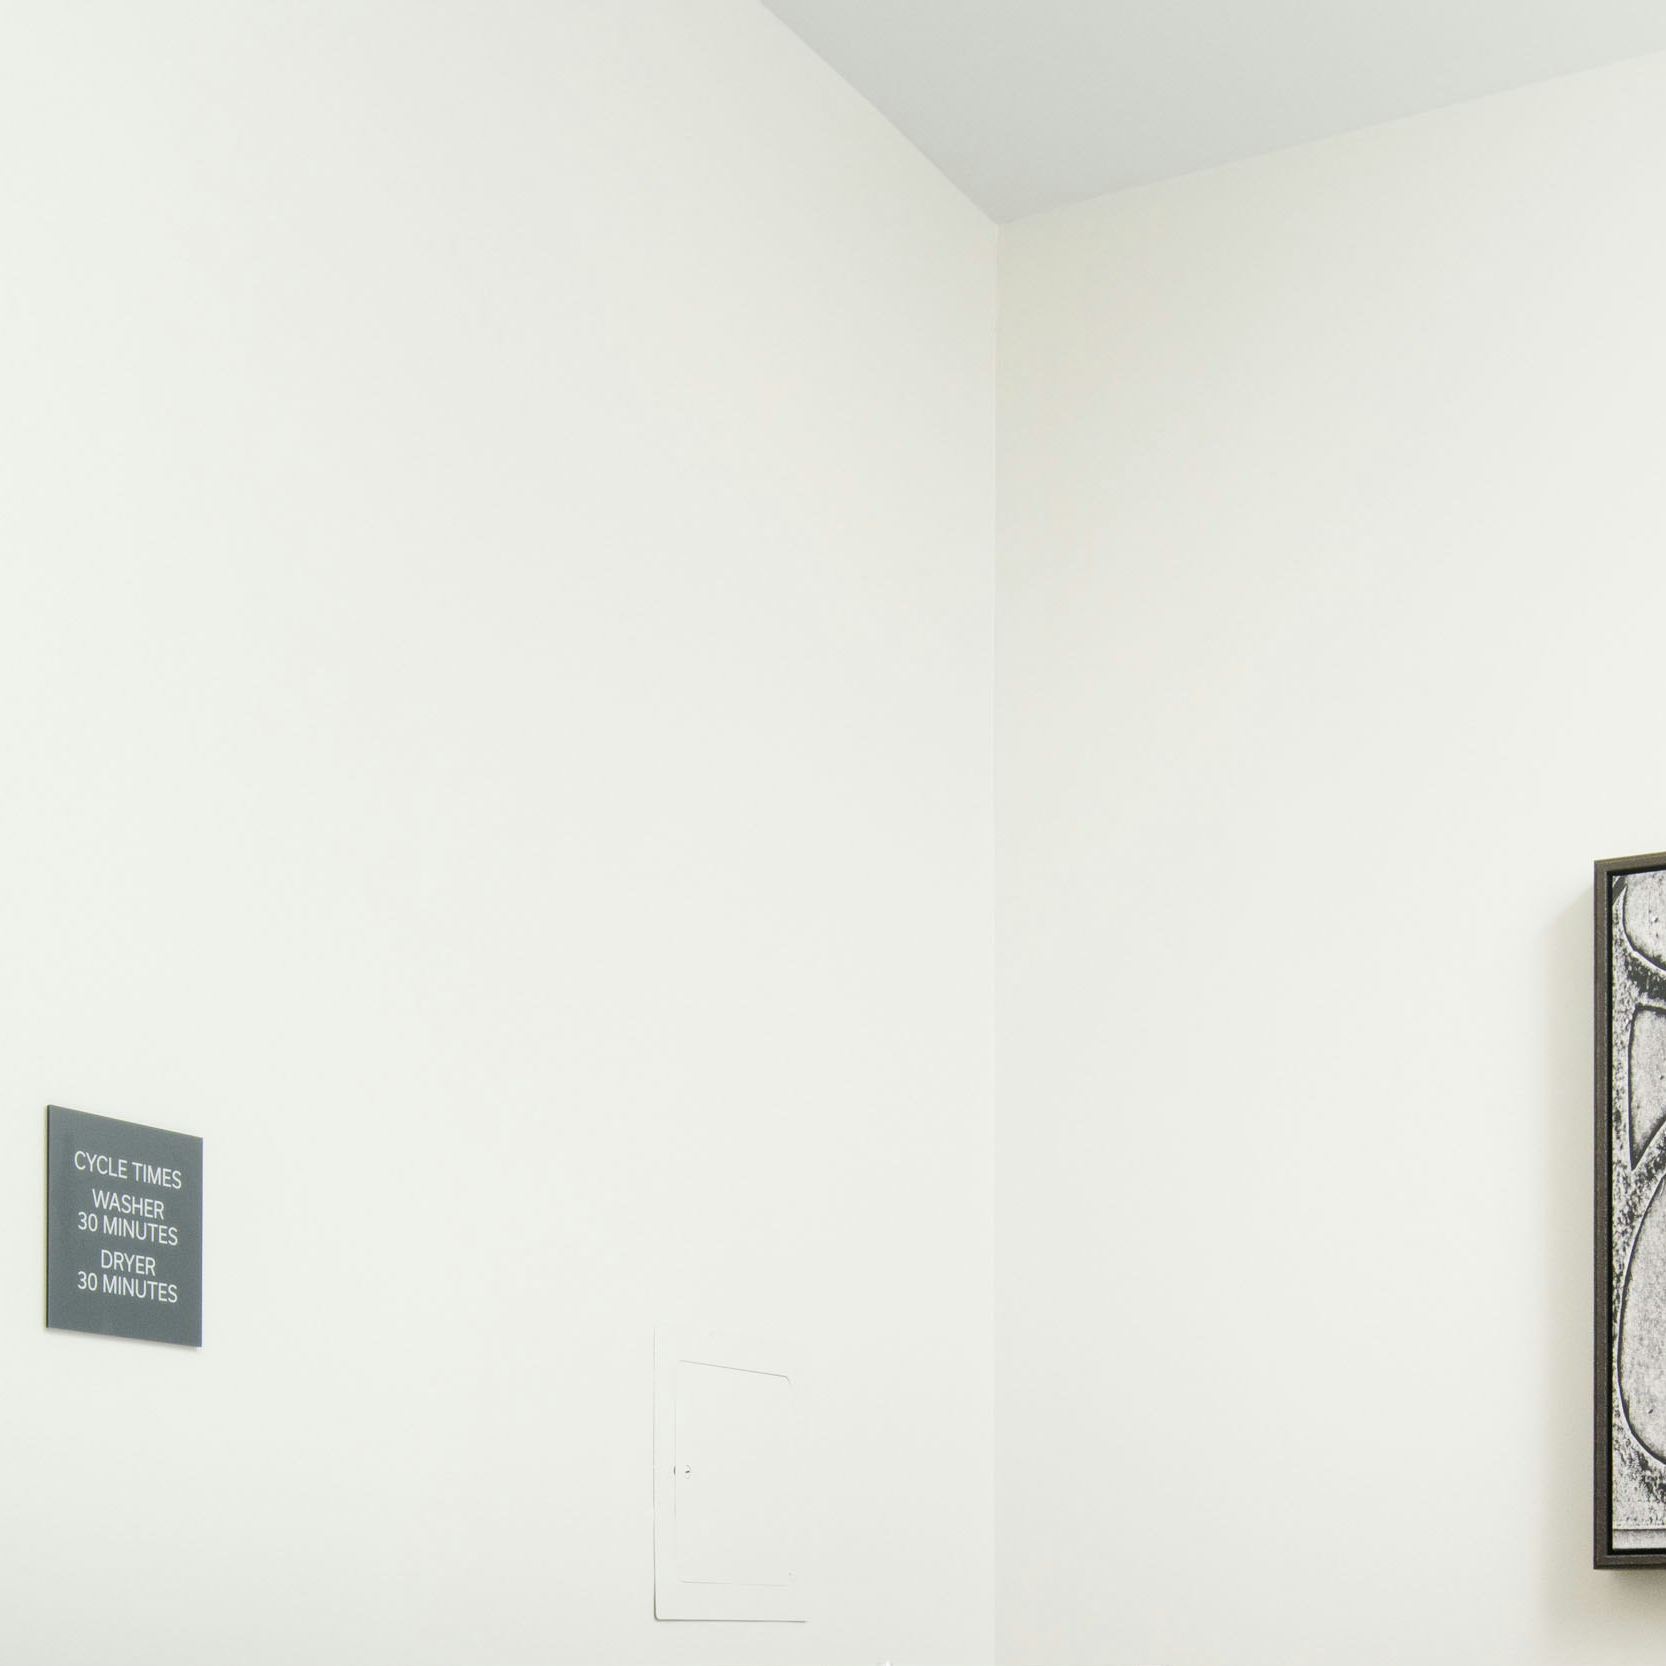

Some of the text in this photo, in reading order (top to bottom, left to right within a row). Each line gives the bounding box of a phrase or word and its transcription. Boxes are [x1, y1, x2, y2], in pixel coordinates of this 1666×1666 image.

[74, 1150, 182, 1190] CYCLE TIMES
[92, 1188, 164, 1220] WASHER
[77, 1211, 178, 1246] 30 MINUTES
[101, 1249, 156, 1276] DRYER
[77, 1271, 178, 1303] 30 MINUTES
